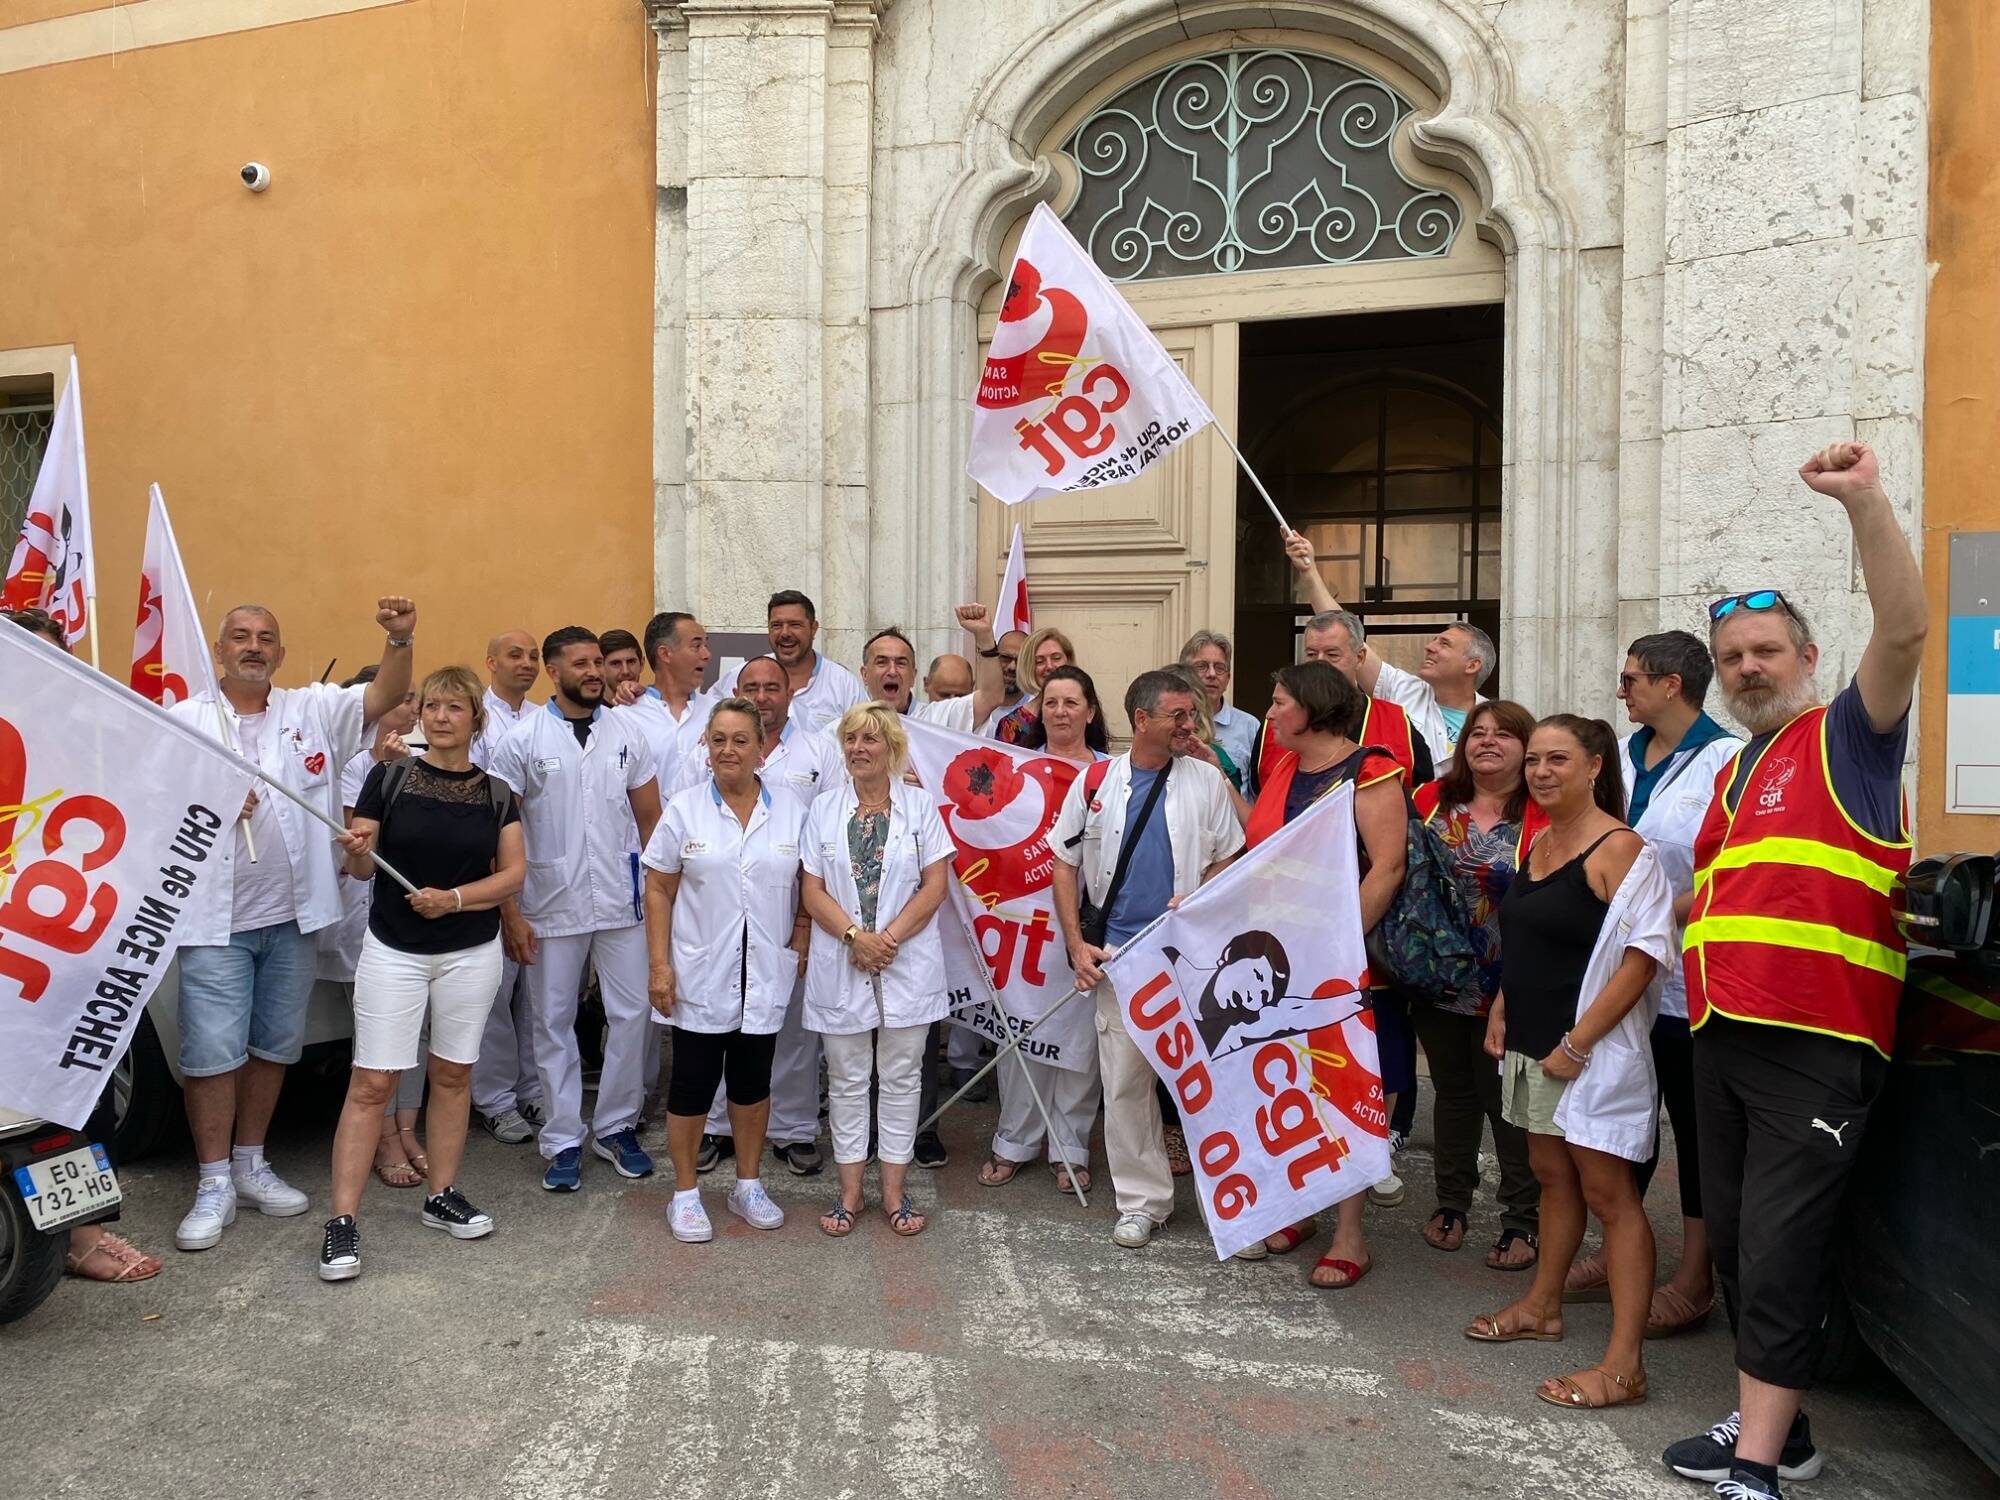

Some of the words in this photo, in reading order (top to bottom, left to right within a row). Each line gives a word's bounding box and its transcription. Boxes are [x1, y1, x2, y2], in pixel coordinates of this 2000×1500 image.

[1759, 789, 1783, 807] cgt
[1024, 855, 1055, 884] ACTIO
[973, 1013, 1060, 1060] PASEUR
[991, 1002, 1034, 1032] NCE
[1129, 971, 1213, 1116] USD
[1199, 1131, 1258, 1221] 06
[1253, 1042, 1350, 1191] cgt
[31, 1174, 113, 1216] 732-HG
